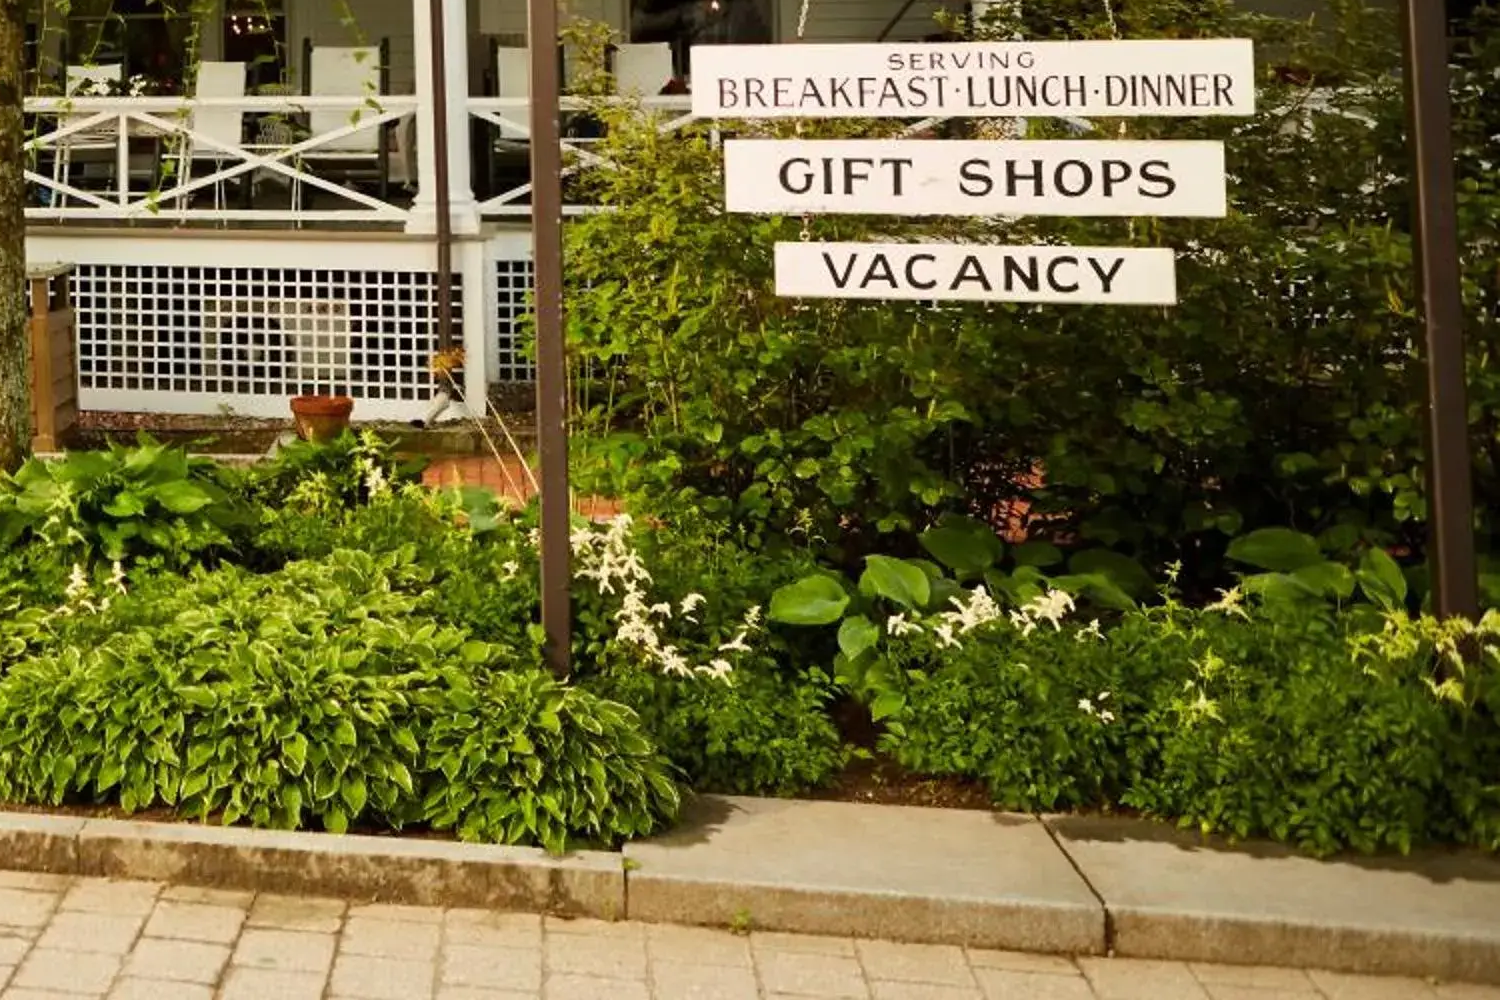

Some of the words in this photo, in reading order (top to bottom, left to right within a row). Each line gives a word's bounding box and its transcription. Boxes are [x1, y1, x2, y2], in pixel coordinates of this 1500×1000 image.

[888, 51, 1036, 71] SERVING
[778, 157, 914, 197] GIFT
[958, 158, 1177, 198] SHOPS
[821, 251, 1126, 294] VACANCY
